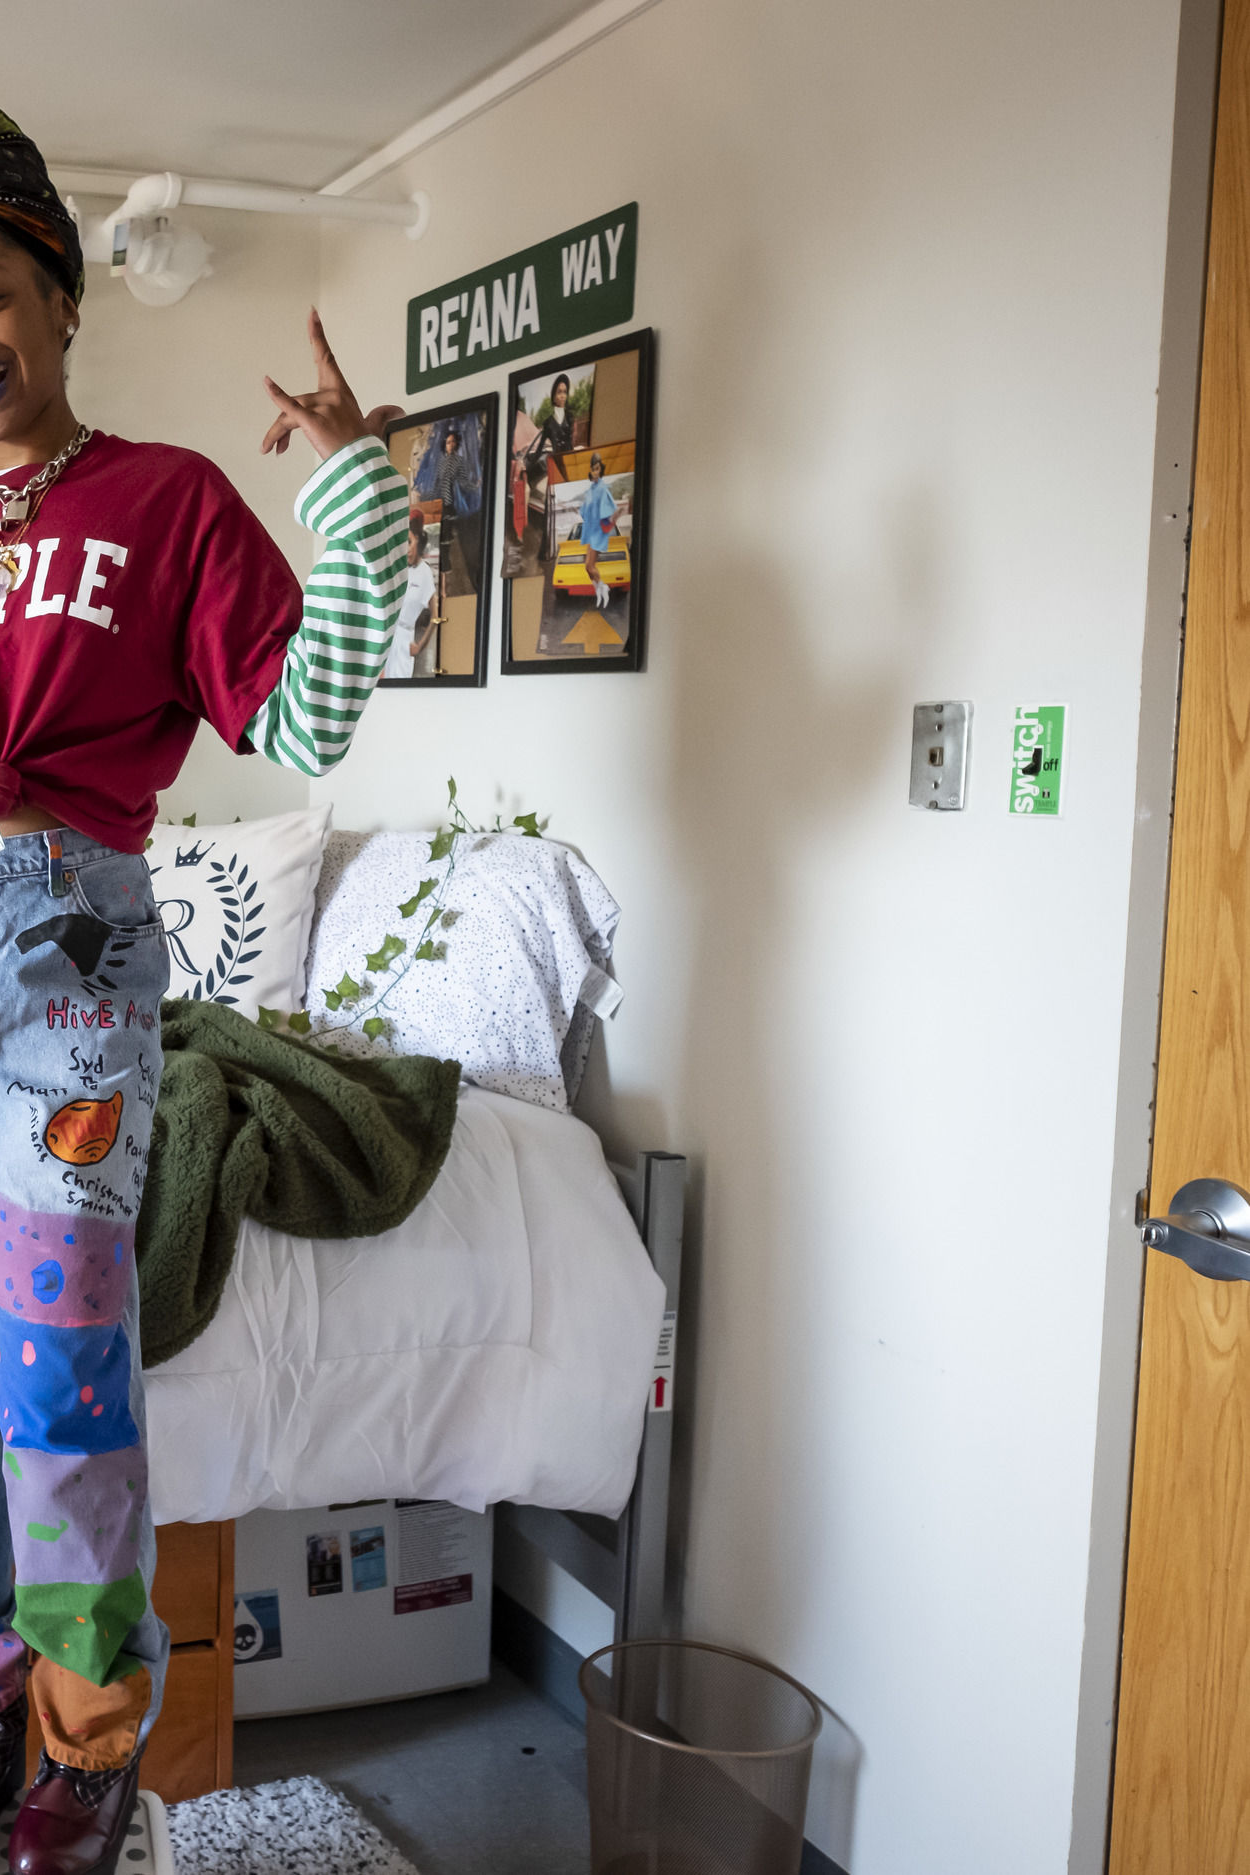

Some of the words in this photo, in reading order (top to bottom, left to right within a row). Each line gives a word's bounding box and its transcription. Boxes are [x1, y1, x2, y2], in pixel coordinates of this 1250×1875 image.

[419, 265, 540, 373] RE'ANA
[561, 223, 625, 298] WAY
[1009, 705, 1044, 813] switch
[1042, 757, 1059, 772] off
[68, 1046, 104, 1075] Syd
